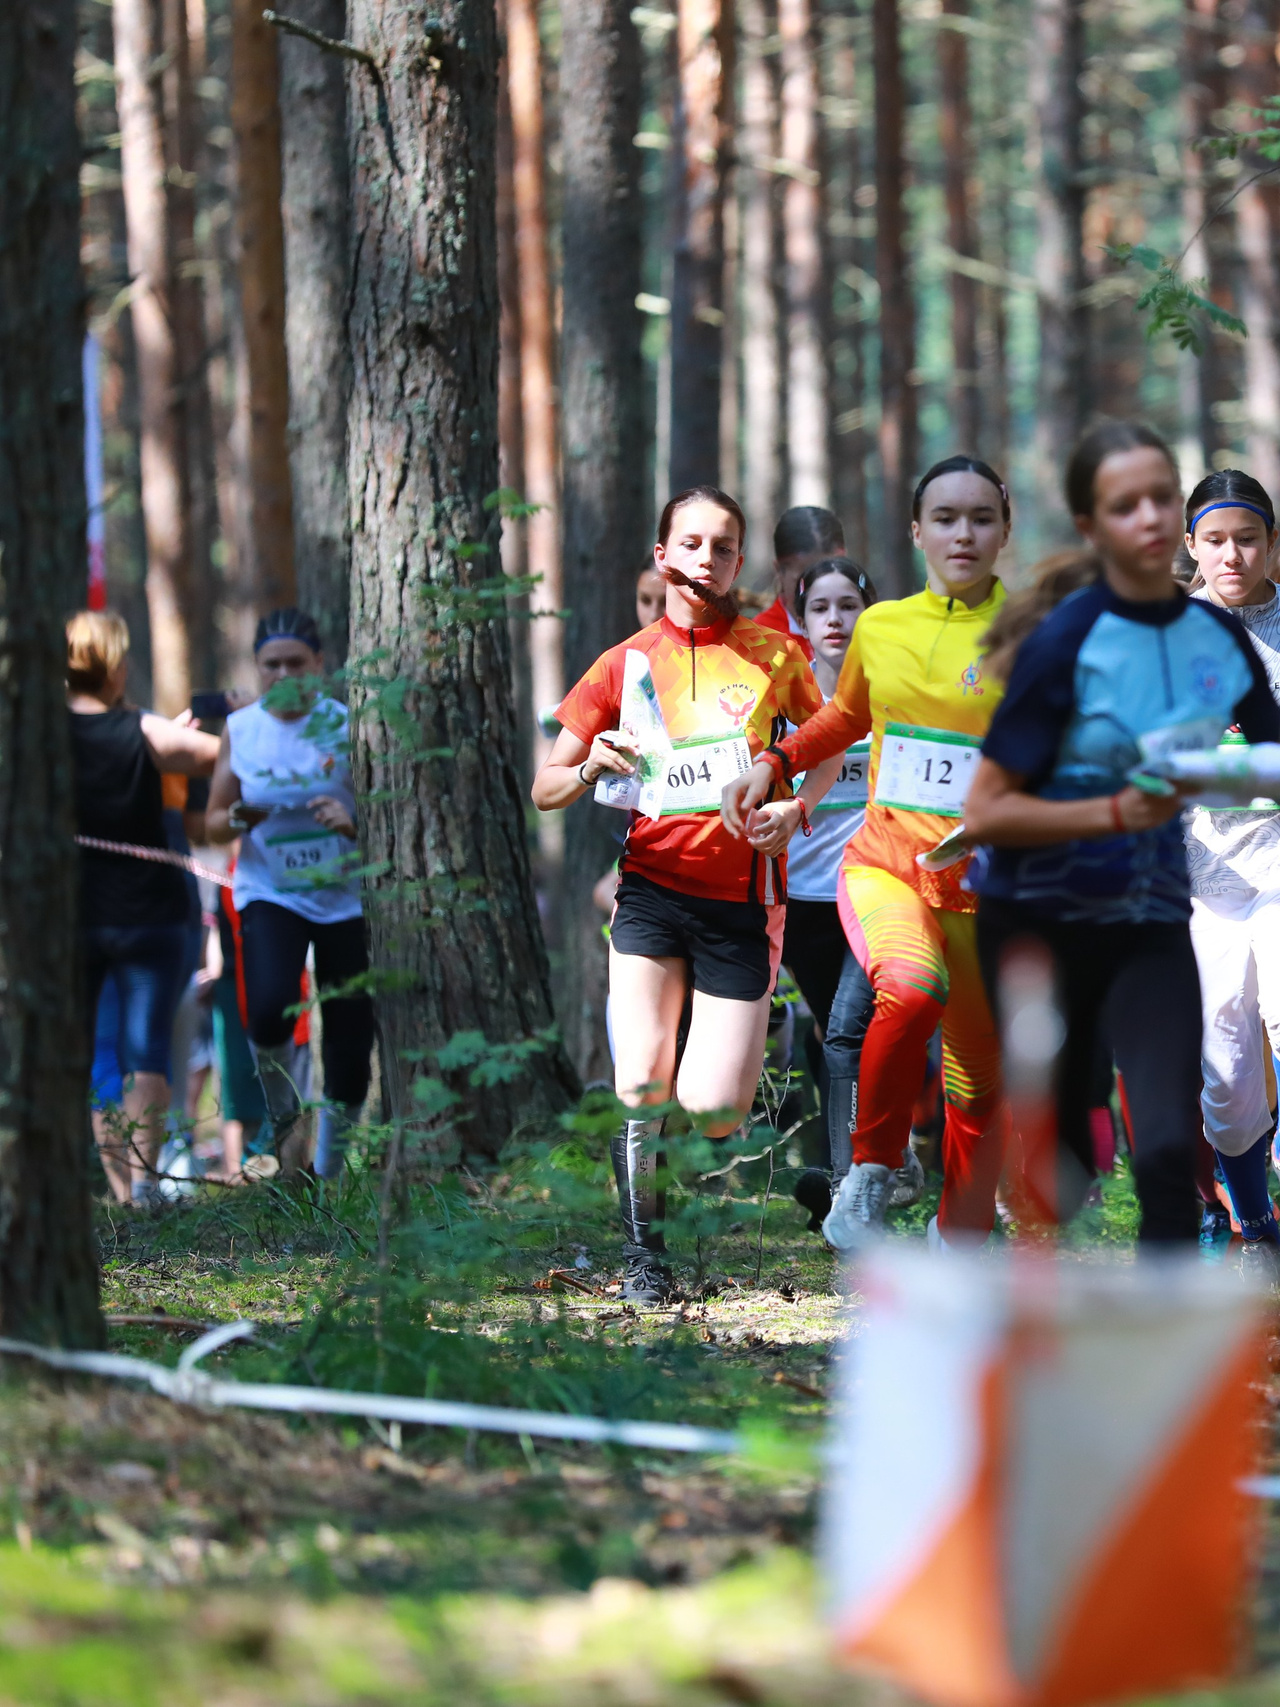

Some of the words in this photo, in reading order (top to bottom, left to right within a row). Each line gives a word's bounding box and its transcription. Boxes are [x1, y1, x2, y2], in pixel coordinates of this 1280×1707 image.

[719, 683, 755, 695] ФЕНИКС
[732, 741, 744, 775] ЕРМСКИЙ
[667, 760, 712, 789] 604
[836, 762, 863, 783] 05
[922, 758, 954, 785] 12
[285, 847, 321, 869] 629
[850, 1081, 858, 1120] NORD
[1241, 1210, 1273, 1228] PSTA
